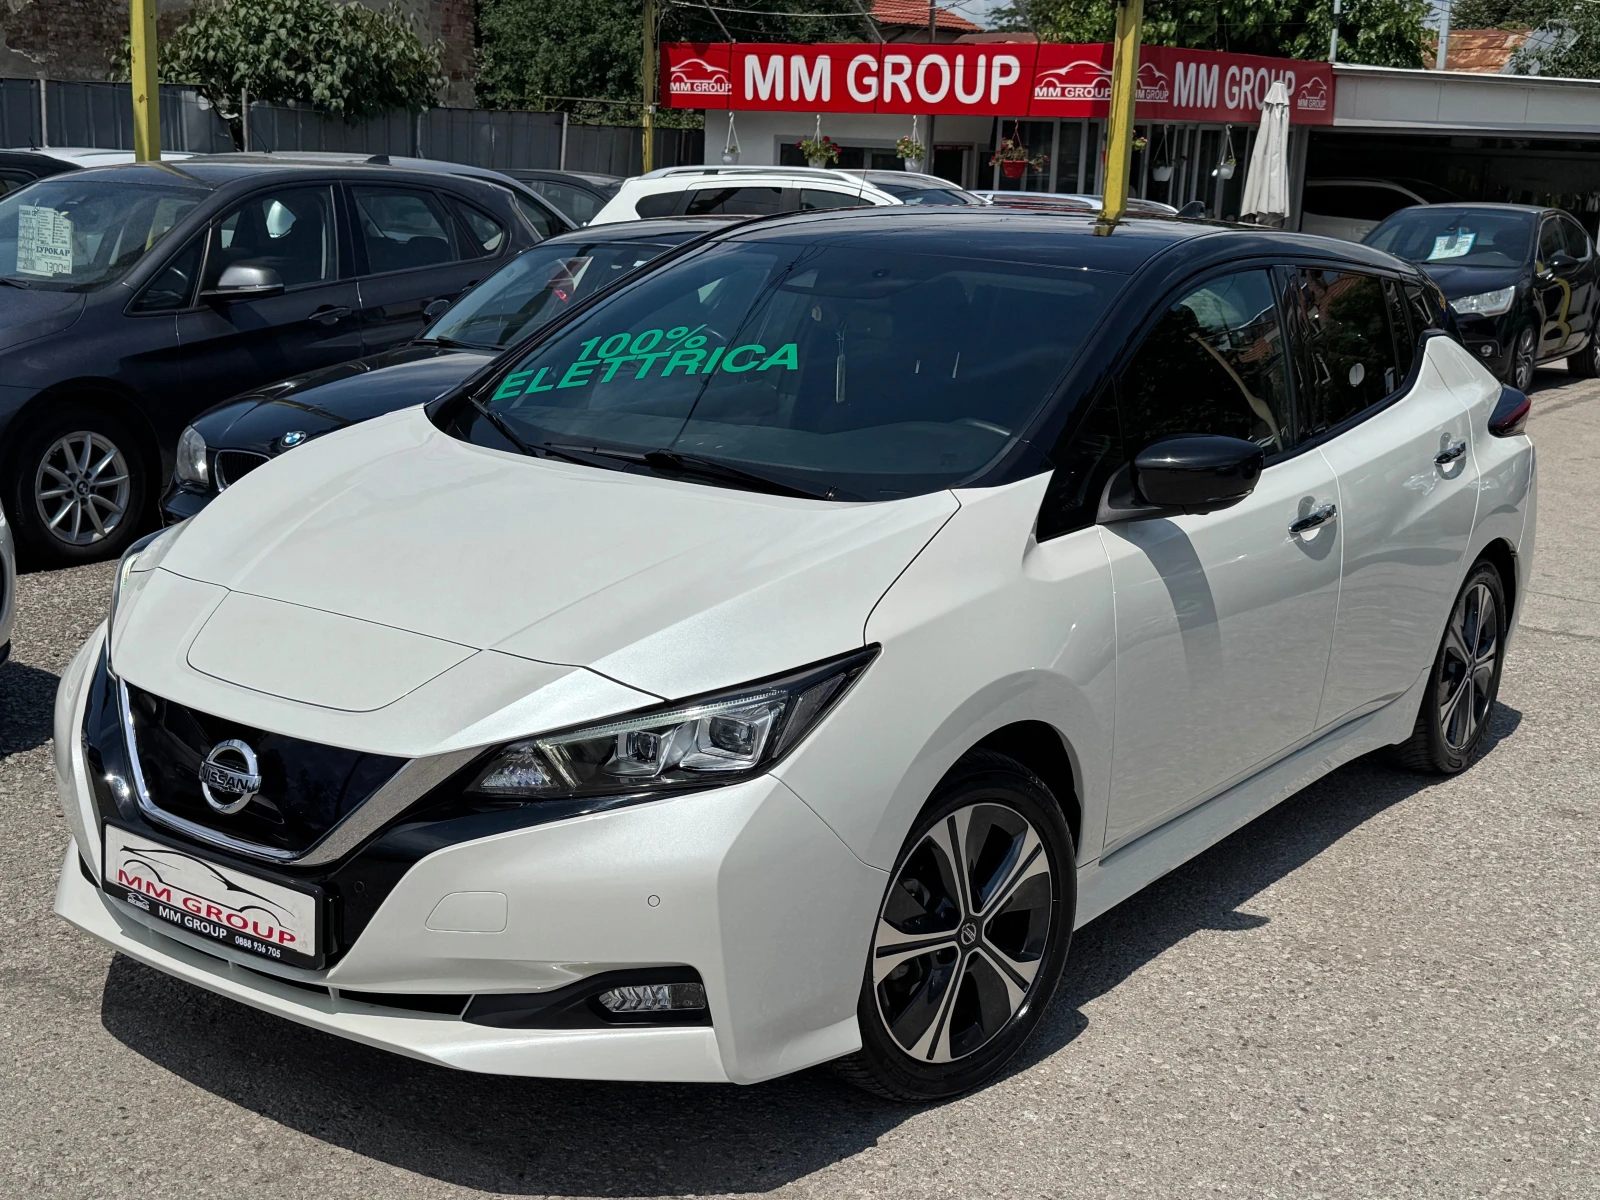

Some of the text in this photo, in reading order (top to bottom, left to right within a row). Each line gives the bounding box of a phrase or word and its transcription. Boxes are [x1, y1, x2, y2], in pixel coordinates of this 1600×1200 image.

[670, 82, 732, 93] MM GROUP
[744, 54, 1020, 104] MM GROUP
[1034, 87, 1112, 98] MM GROUP
[1146, 90, 1169, 99] GROUP
[1173, 61, 1219, 109] MM
[577, 323, 708, 361] 100%
[491, 342, 799, 401] ELETTRICA
[204, 765, 249, 790] NISSAN
[118, 868, 296, 944] MM GROUP
[159, 905, 281, 958] MM GROUP 0888 936 705
